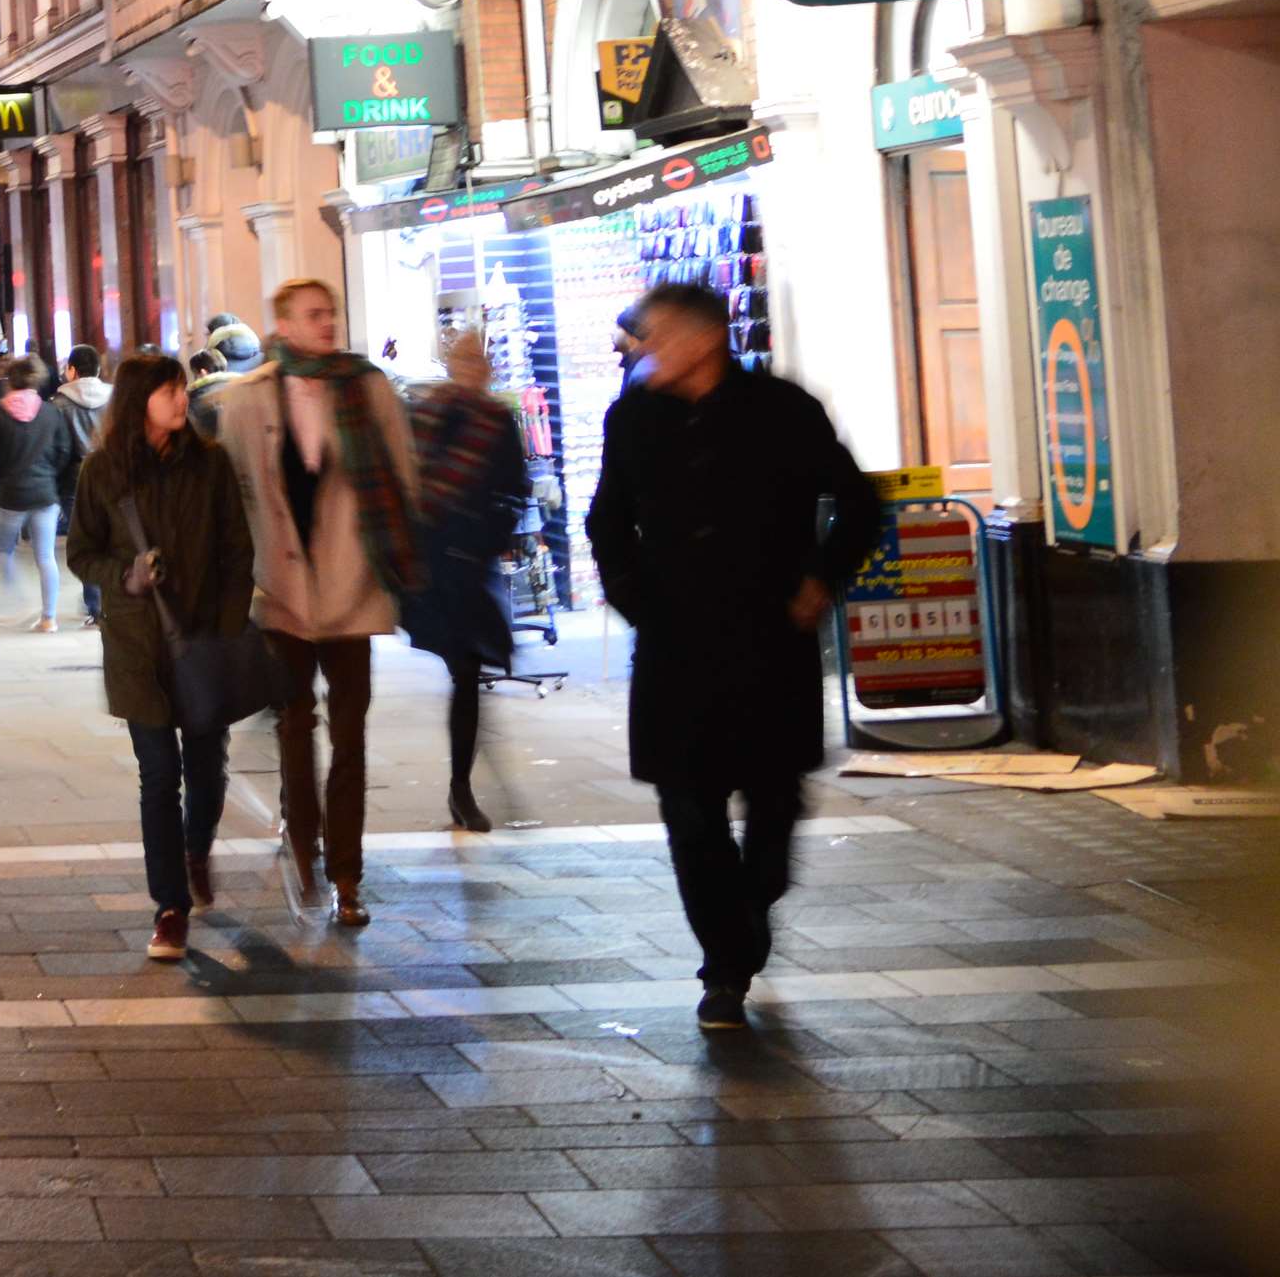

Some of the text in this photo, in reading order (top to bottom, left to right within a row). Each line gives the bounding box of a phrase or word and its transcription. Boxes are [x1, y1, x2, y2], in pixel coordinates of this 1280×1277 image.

[342, 42, 423, 68] FOOD
[371, 65, 400, 98] &
[342, 95, 433, 124] DRINK
[592, 174, 655, 207] oyster
[1037, 212, 1084, 239] bureau
[1053, 243, 1073, 271] de
[1041, 275, 1090, 306] change
